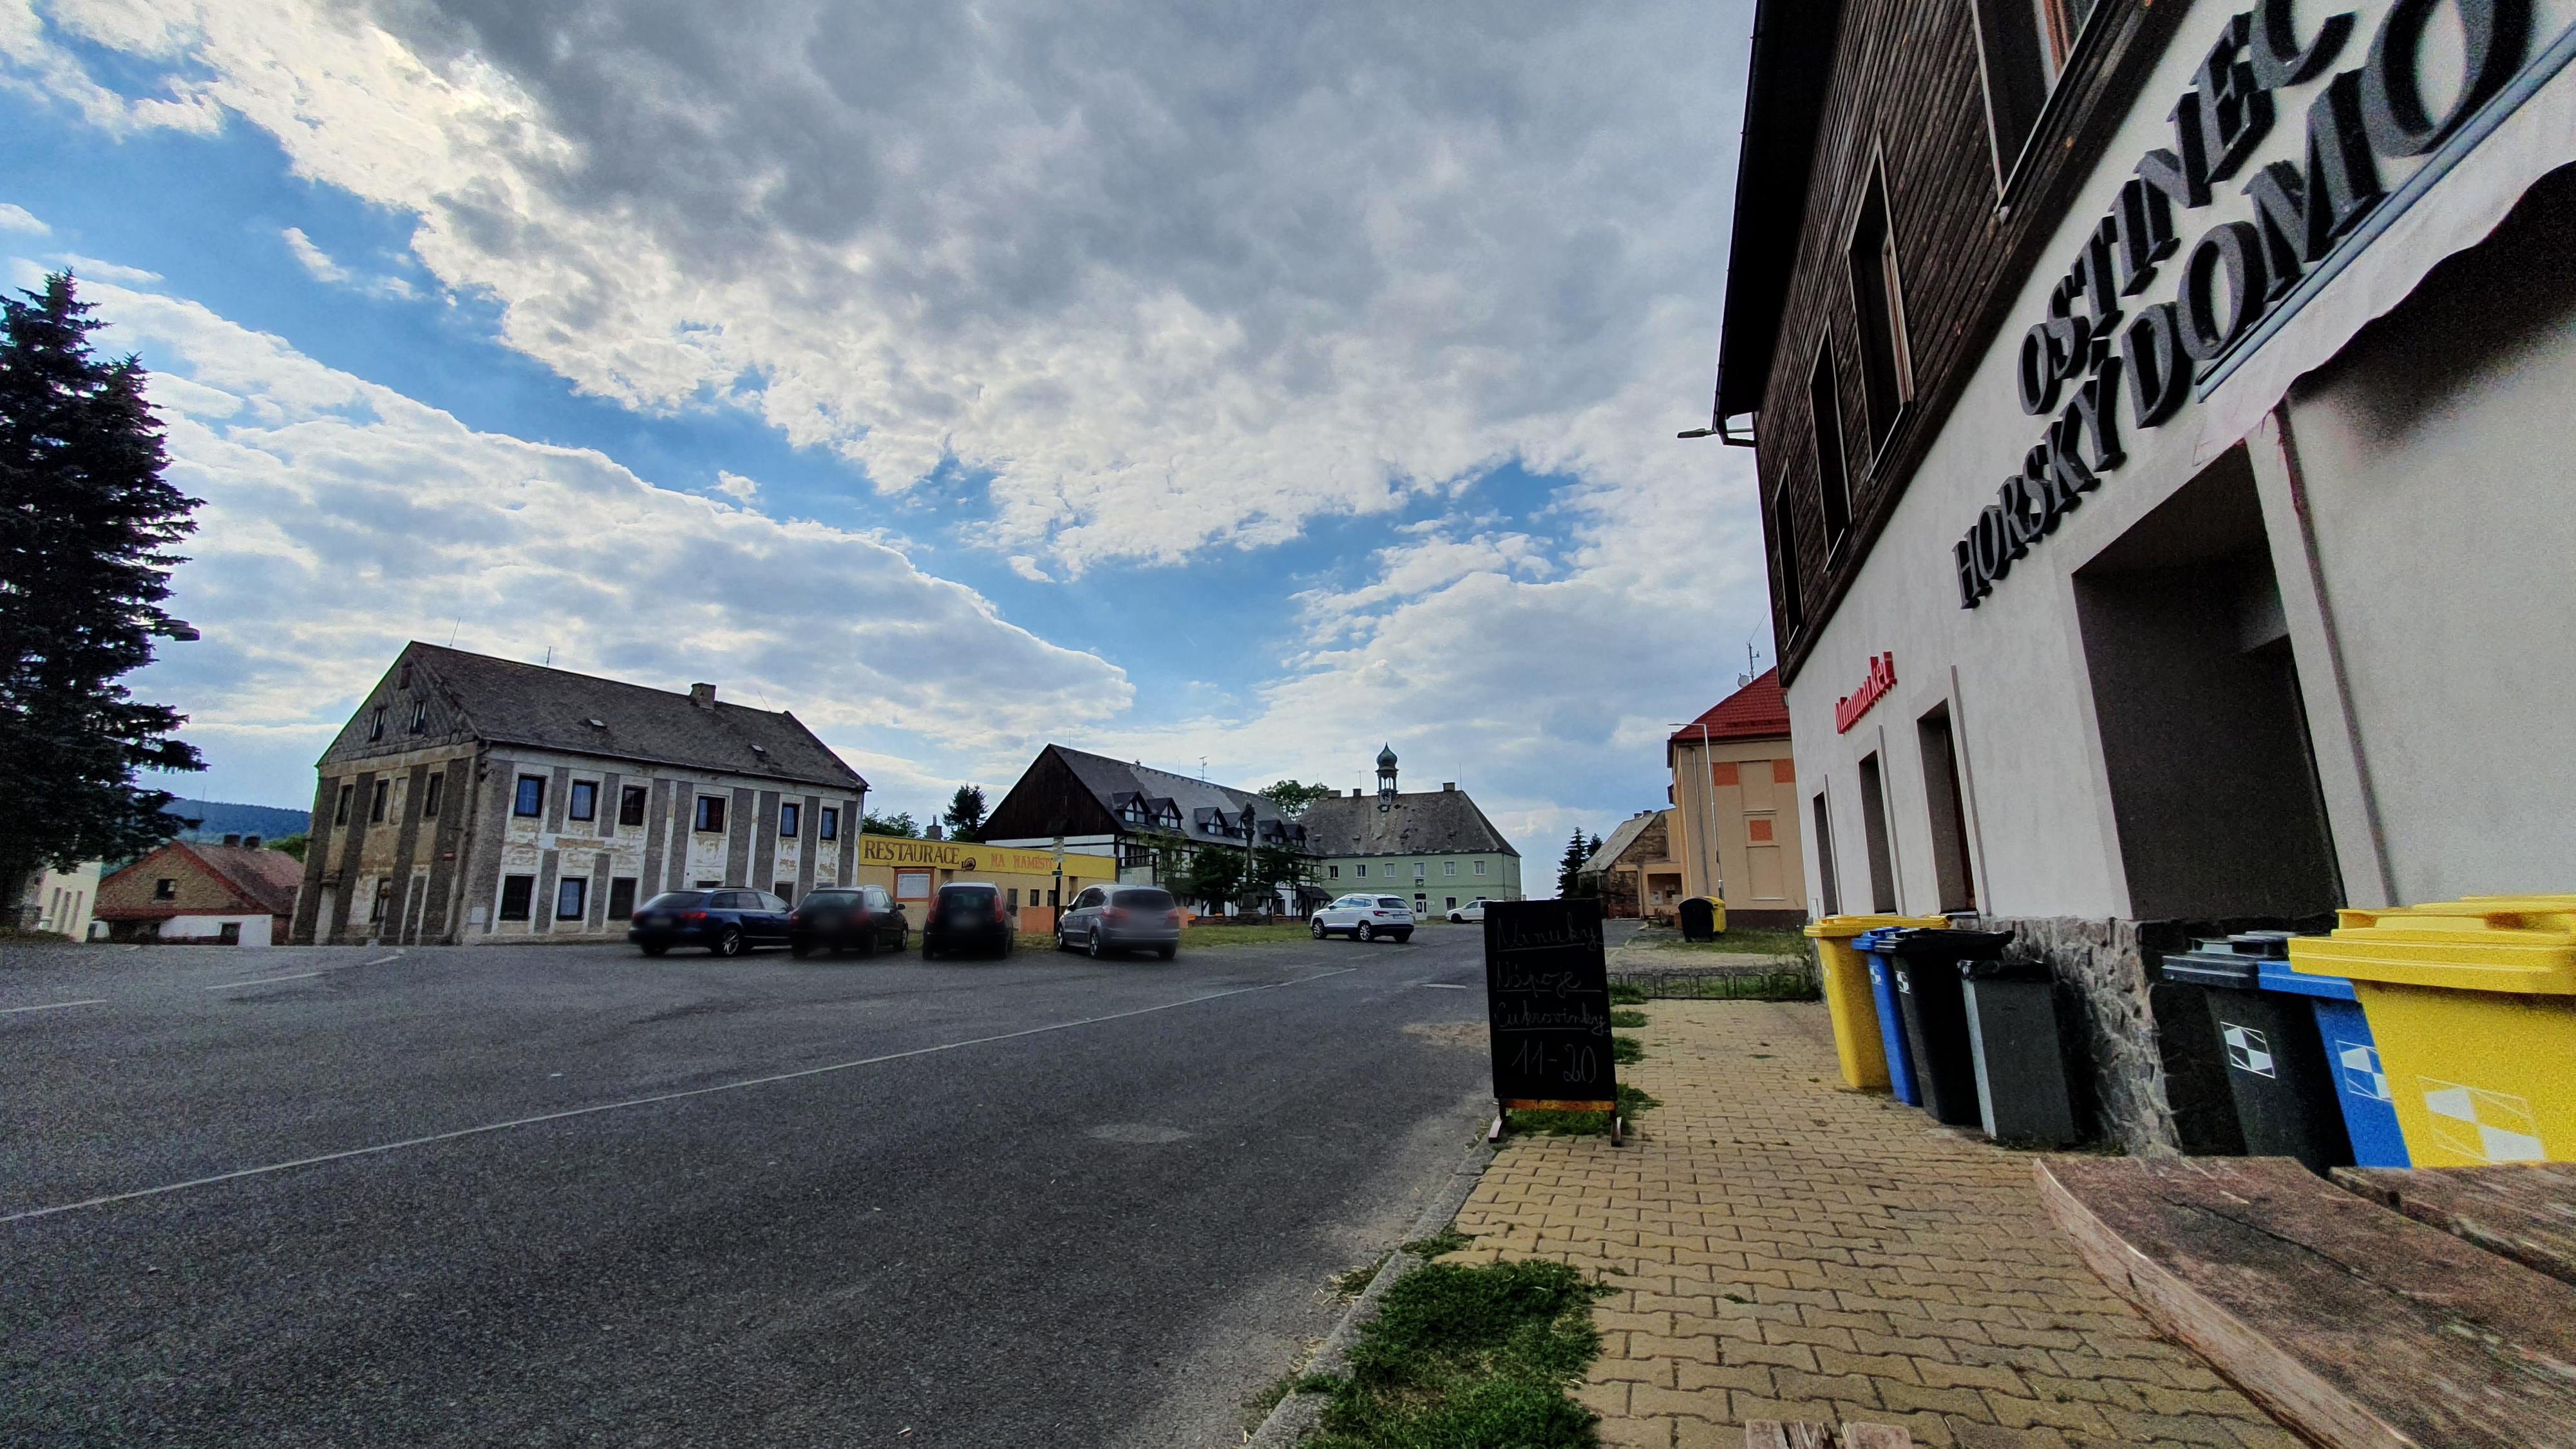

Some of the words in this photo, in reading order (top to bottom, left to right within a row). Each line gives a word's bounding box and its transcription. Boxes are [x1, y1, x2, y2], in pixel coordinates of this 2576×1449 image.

[1951, 337, 2128, 610] HORSKÝ
[864, 840, 960, 864] RESTAURACE
[990, 853, 1005, 867] NA
[1496, 960, 1582, 998] Nápoje
